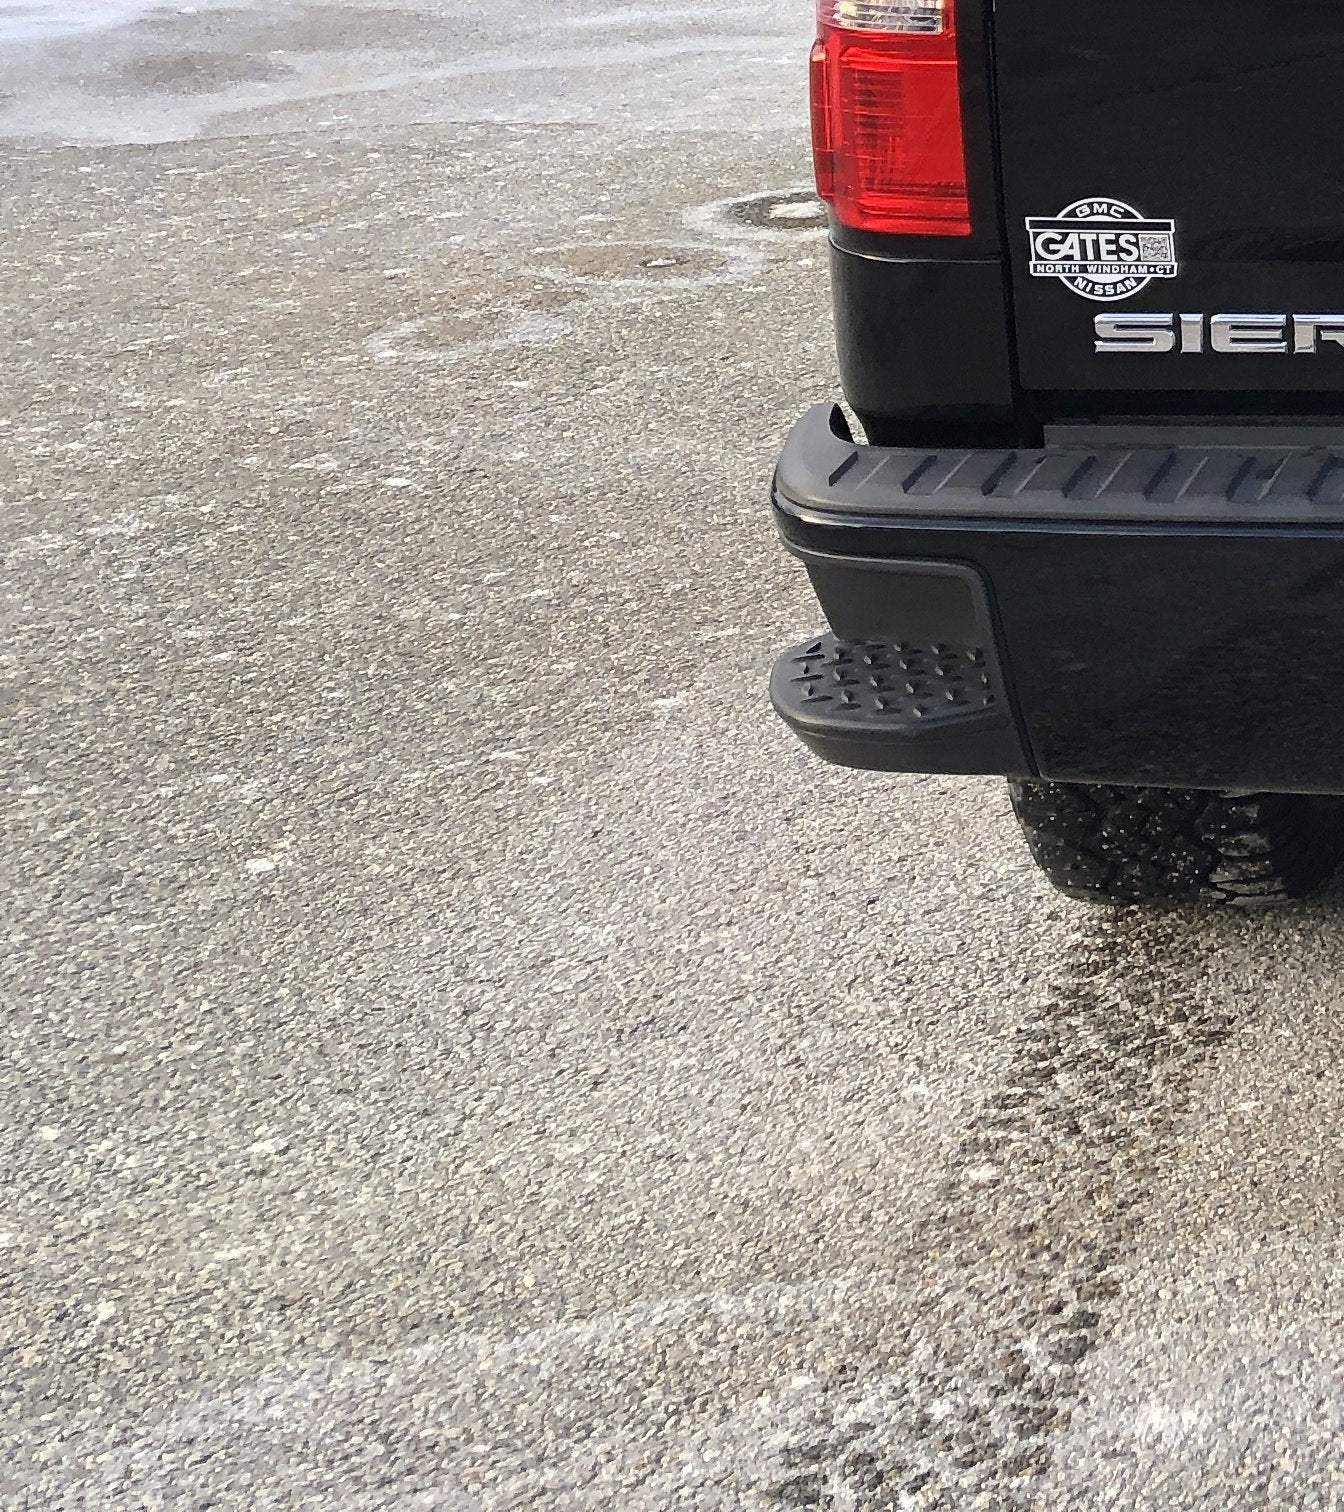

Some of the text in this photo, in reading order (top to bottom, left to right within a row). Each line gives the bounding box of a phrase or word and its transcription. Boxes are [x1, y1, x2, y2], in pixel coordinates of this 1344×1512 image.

[1075, 203, 1125, 219] GMC
[1035, 232, 1139, 262] GATES
[1036, 264, 1080, 273] NORTH
[1073, 276, 1138, 296] NISSAN
